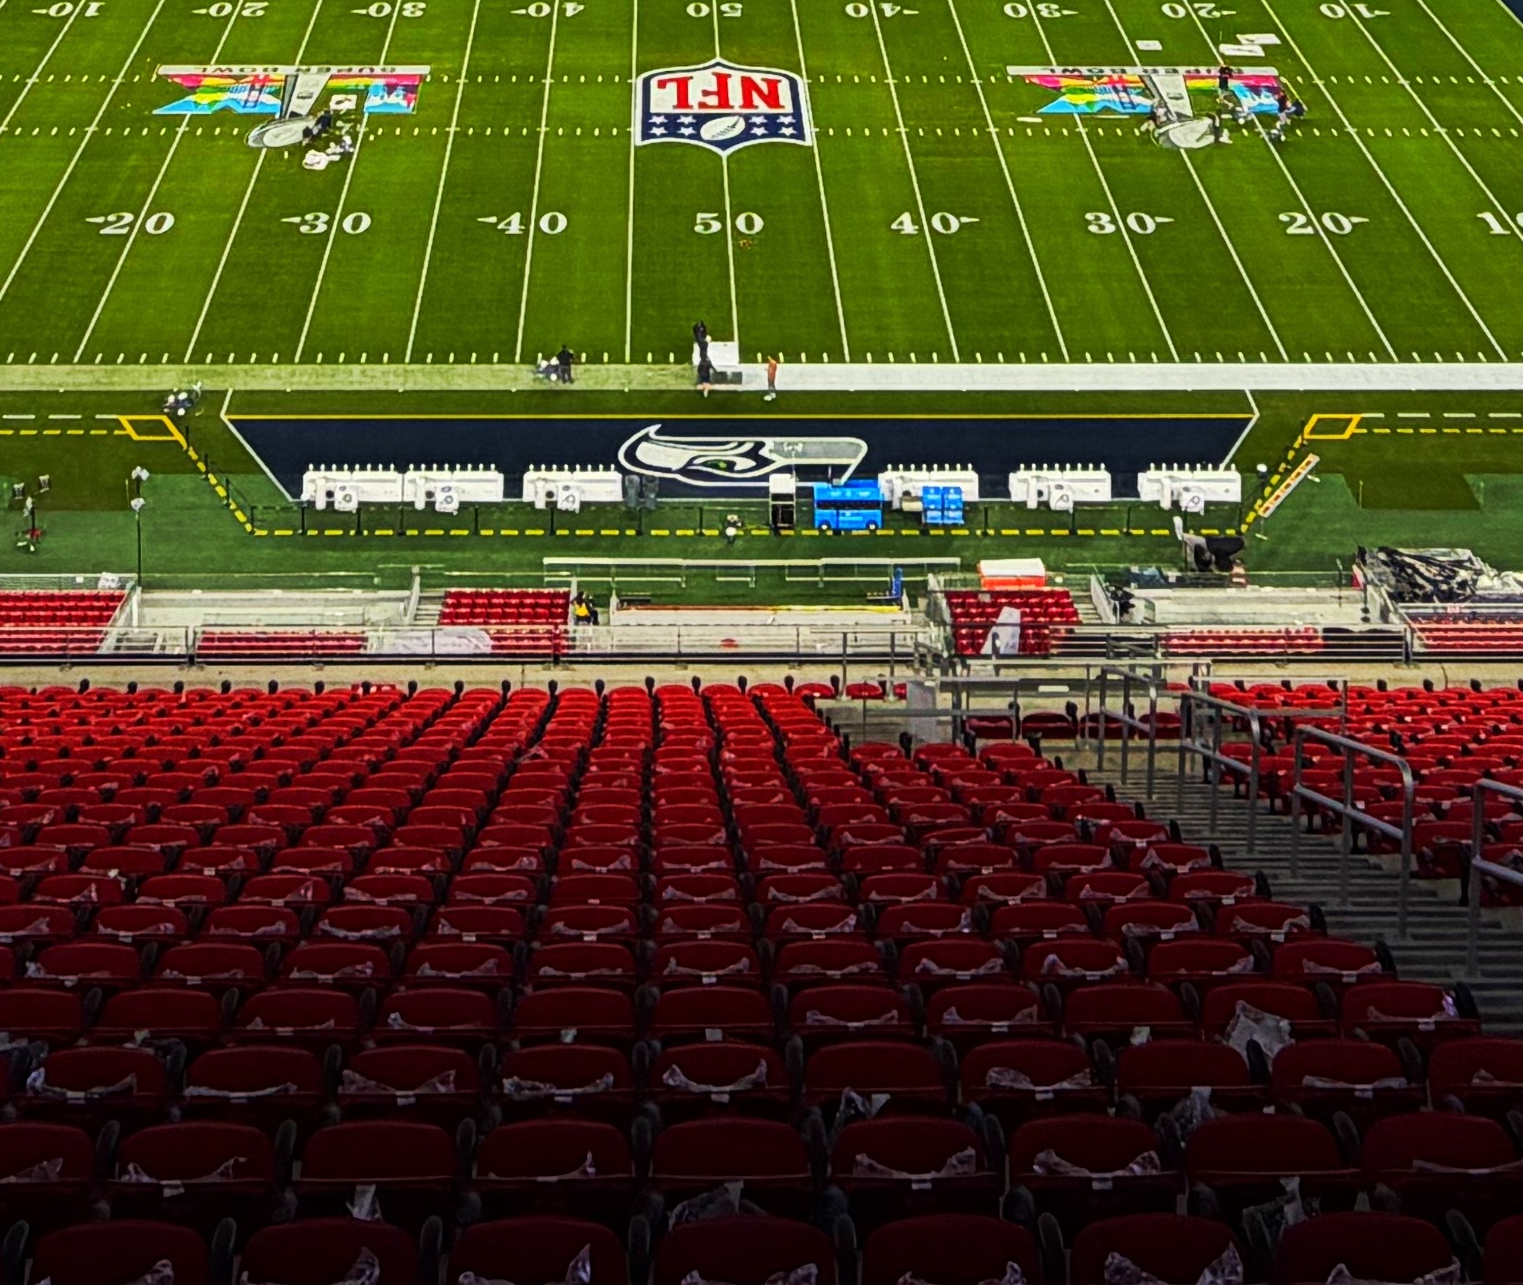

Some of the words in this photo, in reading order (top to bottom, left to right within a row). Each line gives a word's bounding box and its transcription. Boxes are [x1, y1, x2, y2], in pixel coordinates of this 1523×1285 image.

[48, 2, 105, 18] 10
[208, 2, 266, 18] 20
[366, 2, 427, 18] 30
[527, 2, 585, 18] 40
[686, 2, 745, 18] 50
[844, 2, 903, 18] 40
[1003, 2, 1062, 18] 30
[1161, 2, 1220, 18] 20
[1319, 2, 1377, 18] 10
[657, 71, 786, 110] NFL
[97, 212, 175, 235] 20
[297, 212, 372, 235] 30
[496, 212, 568, 235] 40
[693, 212, 765, 235] 50
[890, 212, 962, 235] 40
[1085, 212, 1156, 235] 30
[1278, 212, 1355, 235] 20
